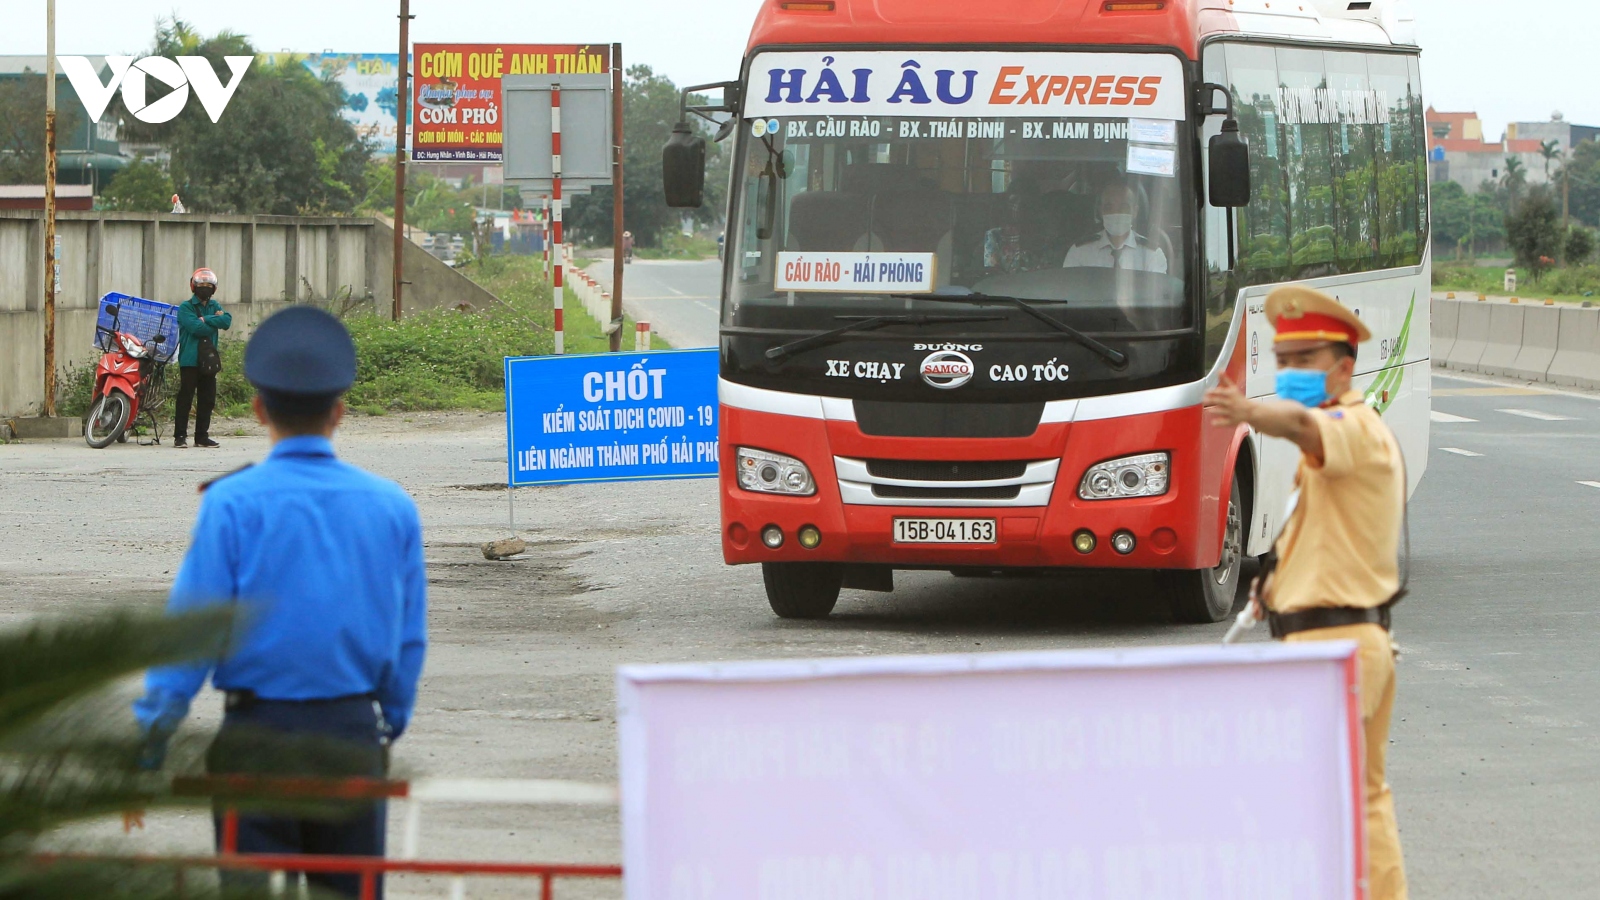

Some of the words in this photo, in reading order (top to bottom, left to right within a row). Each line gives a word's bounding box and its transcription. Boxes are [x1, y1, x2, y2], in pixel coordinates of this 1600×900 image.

[420, 50, 462, 78] CƠM
[468, 48, 504, 80] QUÊ
[510, 54, 548, 74] ANH
[554, 46, 602, 74] TUẤN
[764, 56, 873, 103] HẢI
[886, 60, 978, 104] ÂU
[420, 106, 457, 124] CƠM
[462, 102, 498, 124] PHỞ
[419, 131, 434, 143] CƠM
[448, 129, 464, 143] MÓN
[470, 130, 484, 143] CÁC
[850, 116, 880, 137] RÀO
[967, 118, 1004, 138] BÌNH
[1093, 122, 1129, 142] ĐỊNH
[785, 256, 811, 282] CẦU
[814, 258, 840, 282] RÀO
[853, 256, 875, 282] HẢI
[879, 258, 923, 282] PHÒNG
[913, 342, 984, 352] ĐƯỜNG
[583, 359, 667, 402] CHỐT
[825, 360, 850, 377] XE
[854, 361, 905, 384] CHẠY
[924, 365, 969, 374] SAMCO
[989, 364, 1028, 381] CAO
[1032, 357, 1069, 381] TỐC
[543, 404, 575, 434] KIỂM
[579, 406, 610, 432] SOÁT
[614, 408, 644, 434] DỊCH
[648, 406, 684, 428] COVID
[697, 406, 713, 427] 19
[518, 446, 546, 471] LIÊN
[550, 443, 594, 469] NGÀNH
[597, 441, 639, 466] THÀNH
[642, 436, 668, 465] PHỐ
[672, 436, 693, 463] HẢI
[697, 437, 719, 462] PHÒ
[899, 521, 992, 540] 15B-041.63
